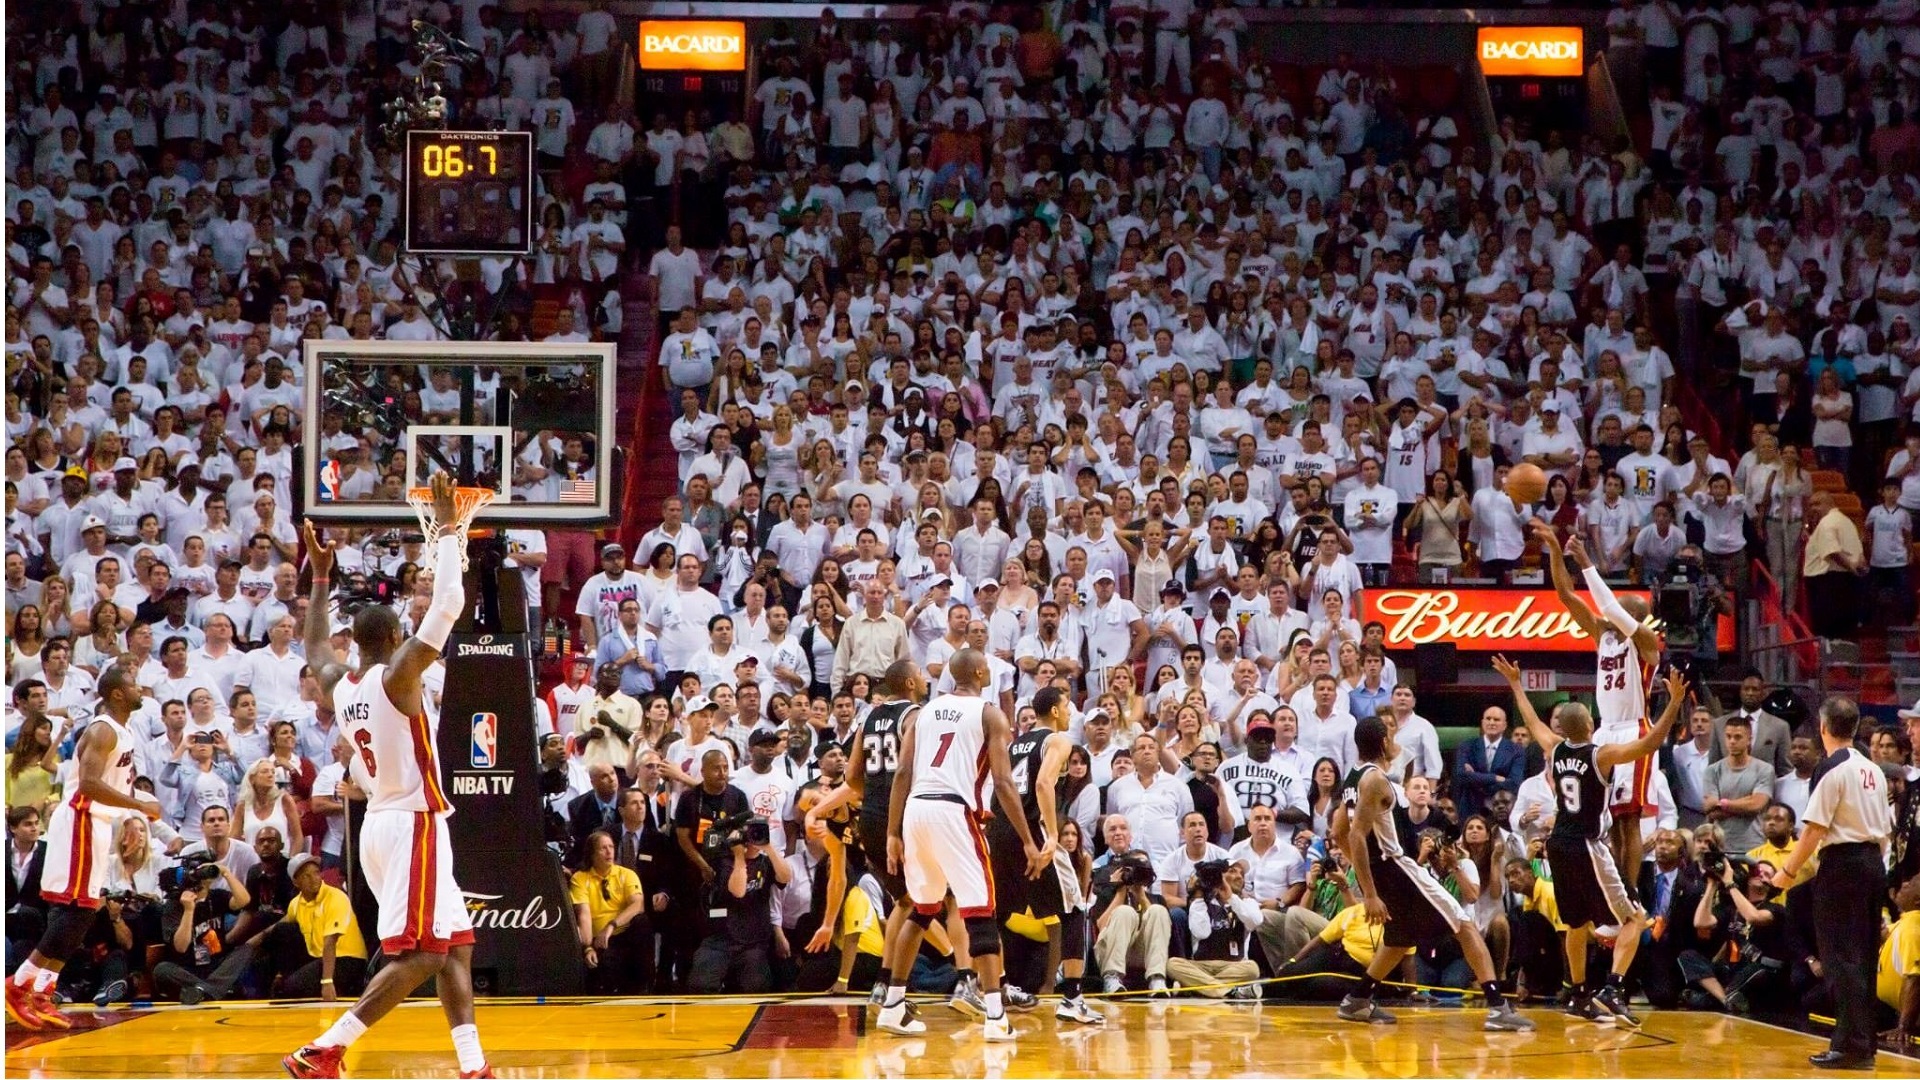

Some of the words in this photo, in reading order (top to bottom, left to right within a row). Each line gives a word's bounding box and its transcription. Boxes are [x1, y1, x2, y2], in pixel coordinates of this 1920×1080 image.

[644, 34, 740, 54] BACARDI
[1482, 41, 1578, 59] BACARDI
[423, 145, 496, 177] 06.7
[1032, 357, 1058, 368] HEAT
[1046, 370, 1054, 380] 3
[1400, 454, 1414, 466] 15
[859, 573, 878, 581] HEA
[600, 583, 637, 594] MIAMI
[457, 643, 514, 657] SPALDING
[1527, 673, 1550, 690] EXIT
[1604, 671, 1626, 692] 34
[934, 709, 964, 723] BOSH
[354, 727, 377, 778] 6
[862, 733, 899, 775] 33
[930, 732, 956, 768] 1
[1555, 758, 1588, 776] PARKER
[453, 776, 488, 795] NBA
[491, 776, 514, 795] TV
[1860, 768, 1876, 791] 24
[1560, 775, 1582, 814] 9
